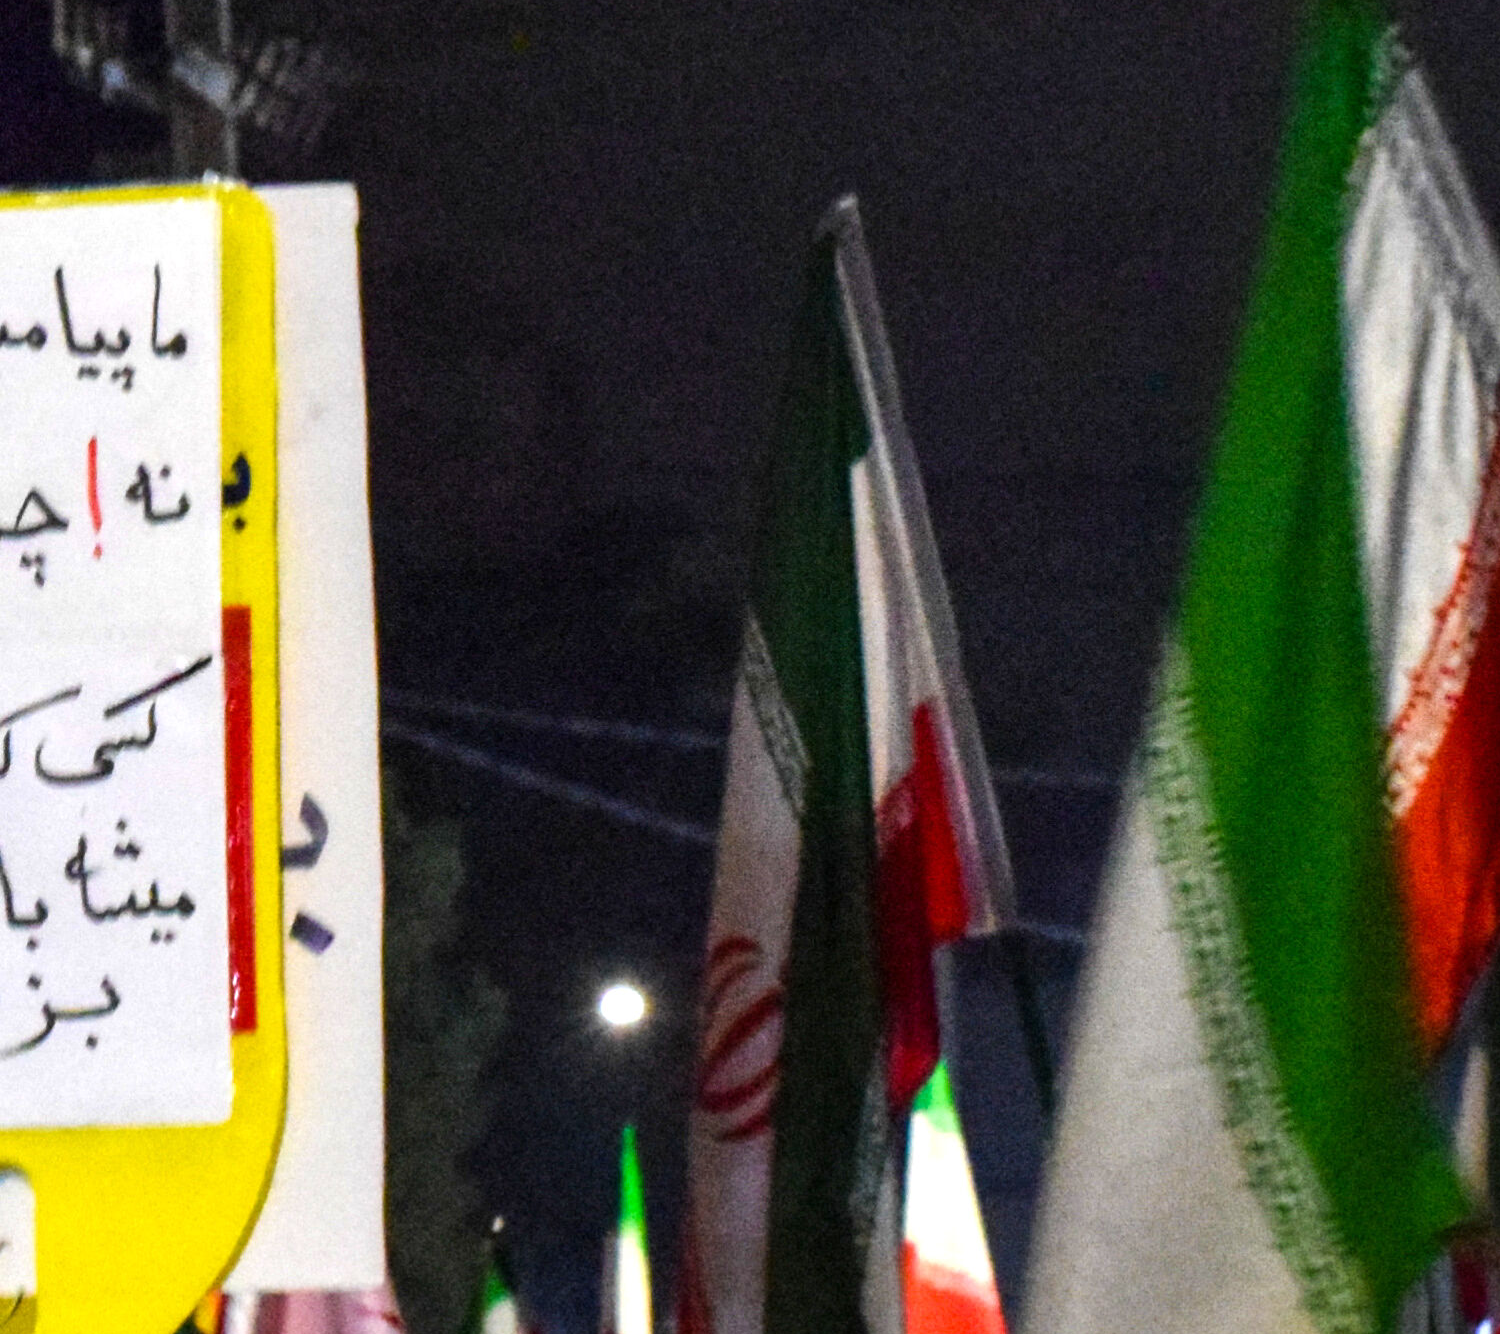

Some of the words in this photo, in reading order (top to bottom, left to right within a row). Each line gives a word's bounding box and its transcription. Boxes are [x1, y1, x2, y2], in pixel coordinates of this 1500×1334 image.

[150, 264, 188, 359] ما
[34, 653, 214, 786] کسی
[64, 817, 196, 944] میشه
